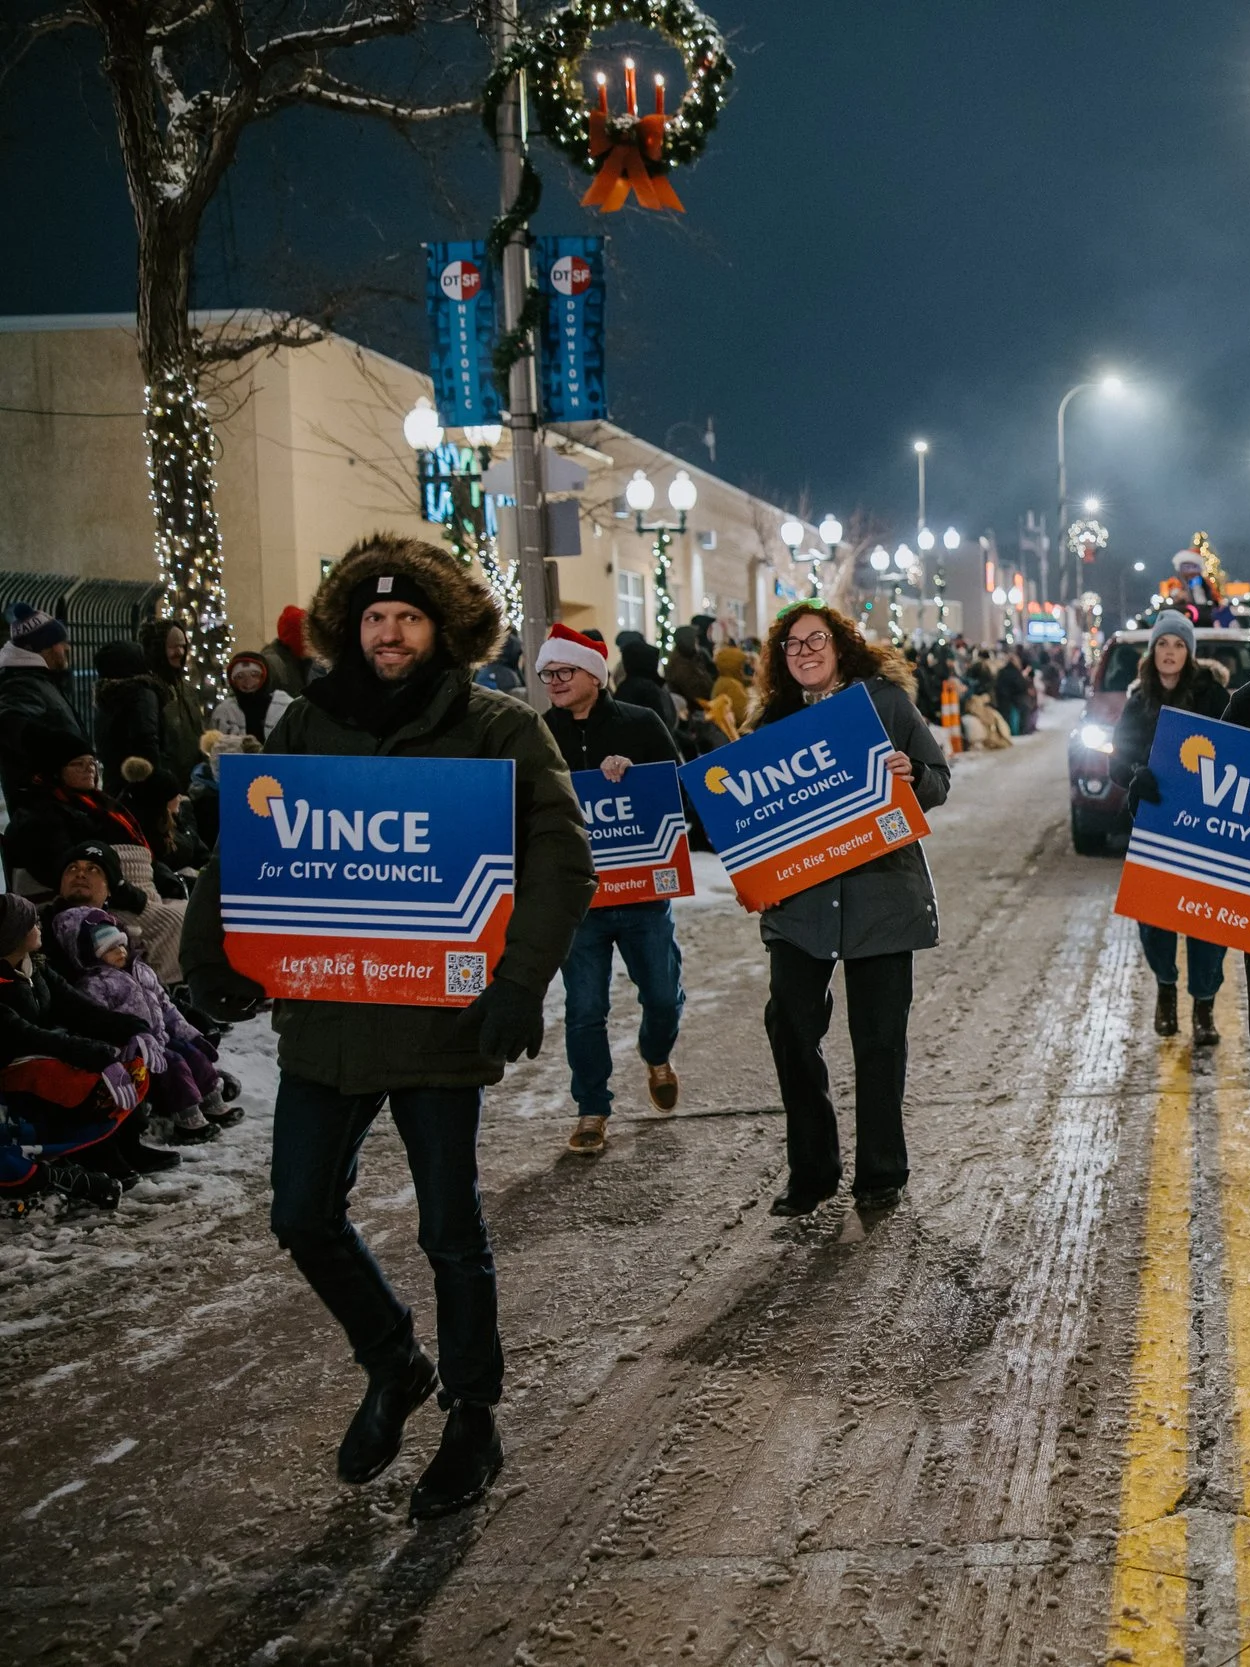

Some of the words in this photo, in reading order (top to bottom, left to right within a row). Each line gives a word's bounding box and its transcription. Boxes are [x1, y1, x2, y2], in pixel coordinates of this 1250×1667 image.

[457, 304, 472, 409] HISTORIC
[566, 300, 579, 407] DOWNTOWN
[720, 739, 837, 807] VINCE
[580, 796, 635, 825] NCE
[736, 817, 751, 833] for
[753, 799, 785, 821] CITY
[788, 769, 854, 805] COUNCIL
[1173, 809, 1200, 828] for
[268, 799, 431, 853] VINCE
[258, 861, 284, 880] for
[289, 861, 337, 879] CITY
[343, 863, 443, 883] COUNCIL
[776, 862, 802, 881] Let's
[803, 854, 825, 871] Rise
[826, 830, 874, 859] Together
[602, 879, 648, 894] Together
[1177, 896, 1213, 919] Let's
[1216, 906, 1249, 929] Rise
[281, 956, 318, 974] Let's
[323, 959, 356, 976] Rise
[361, 959, 434, 980] Together
